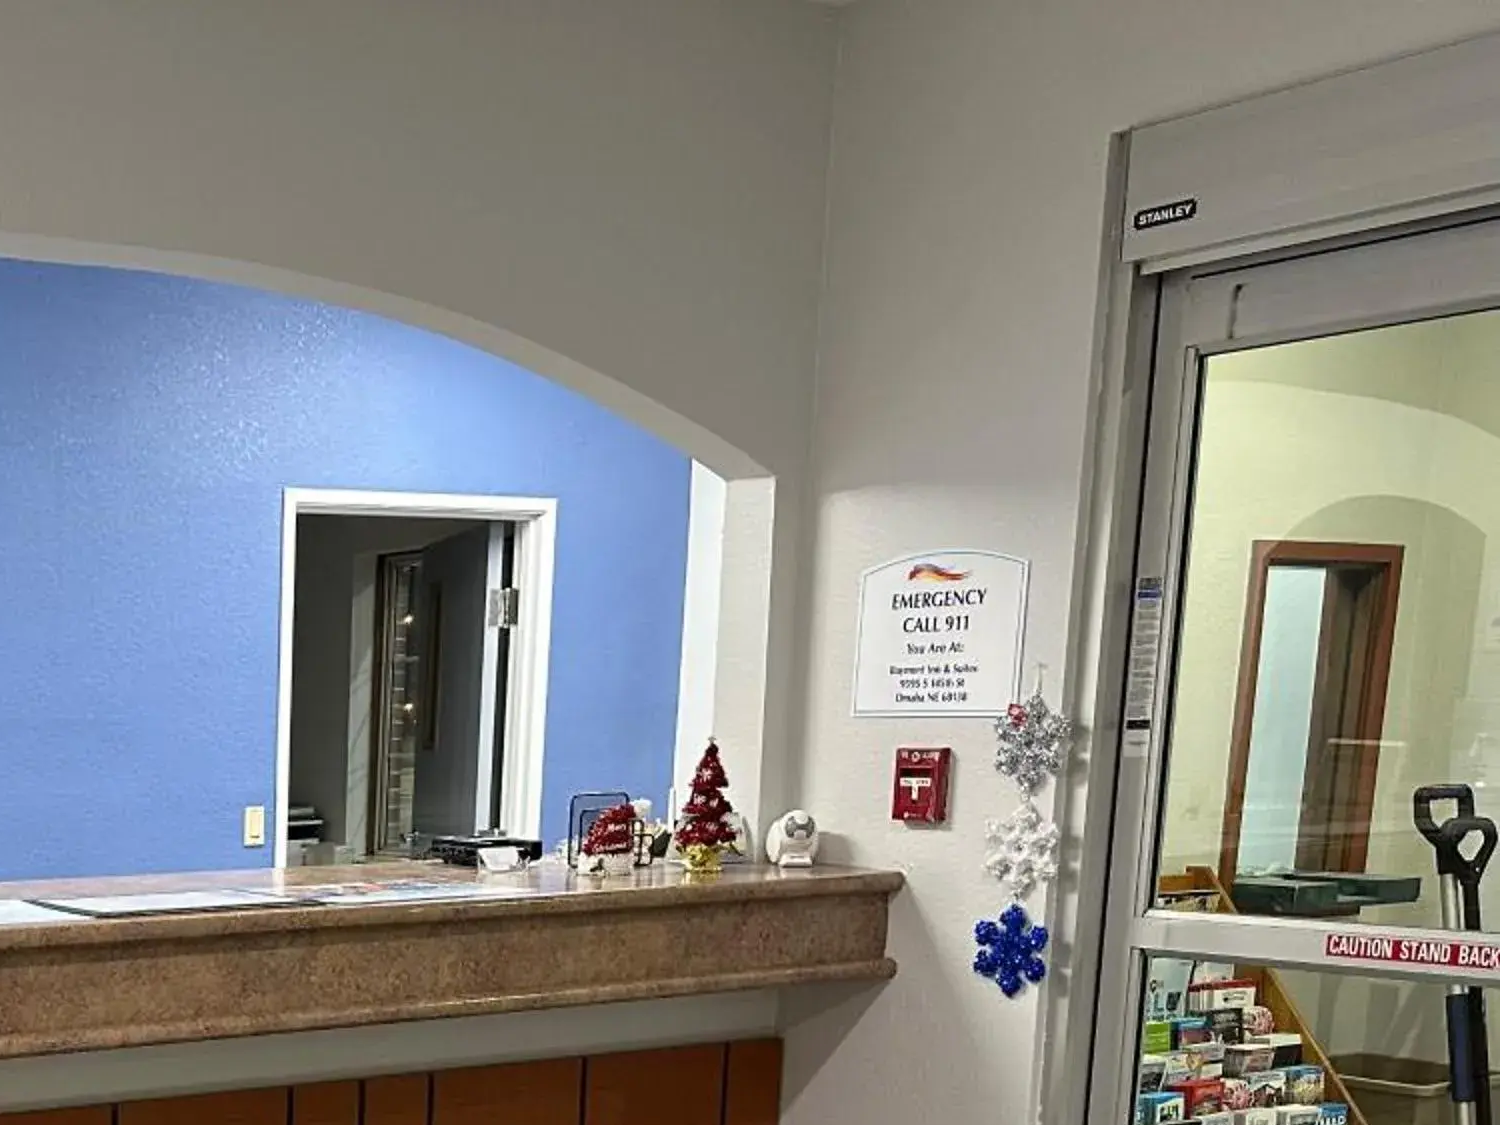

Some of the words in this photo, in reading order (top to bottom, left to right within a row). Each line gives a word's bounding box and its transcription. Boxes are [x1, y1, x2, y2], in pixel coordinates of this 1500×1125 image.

[1137, 202, 1193, 226] STANLEY
[892, 587, 987, 610] EMERGENCY
[903, 616, 941, 633] CALL
[945, 615, 970, 631] 911
[906, 643, 925, 655] You
[927, 643, 947, 655] Are
[1329, 935, 1393, 959] CAUTION
[1400, 940, 1451, 964] STAND
[1457, 944, 1500, 968] BACK
